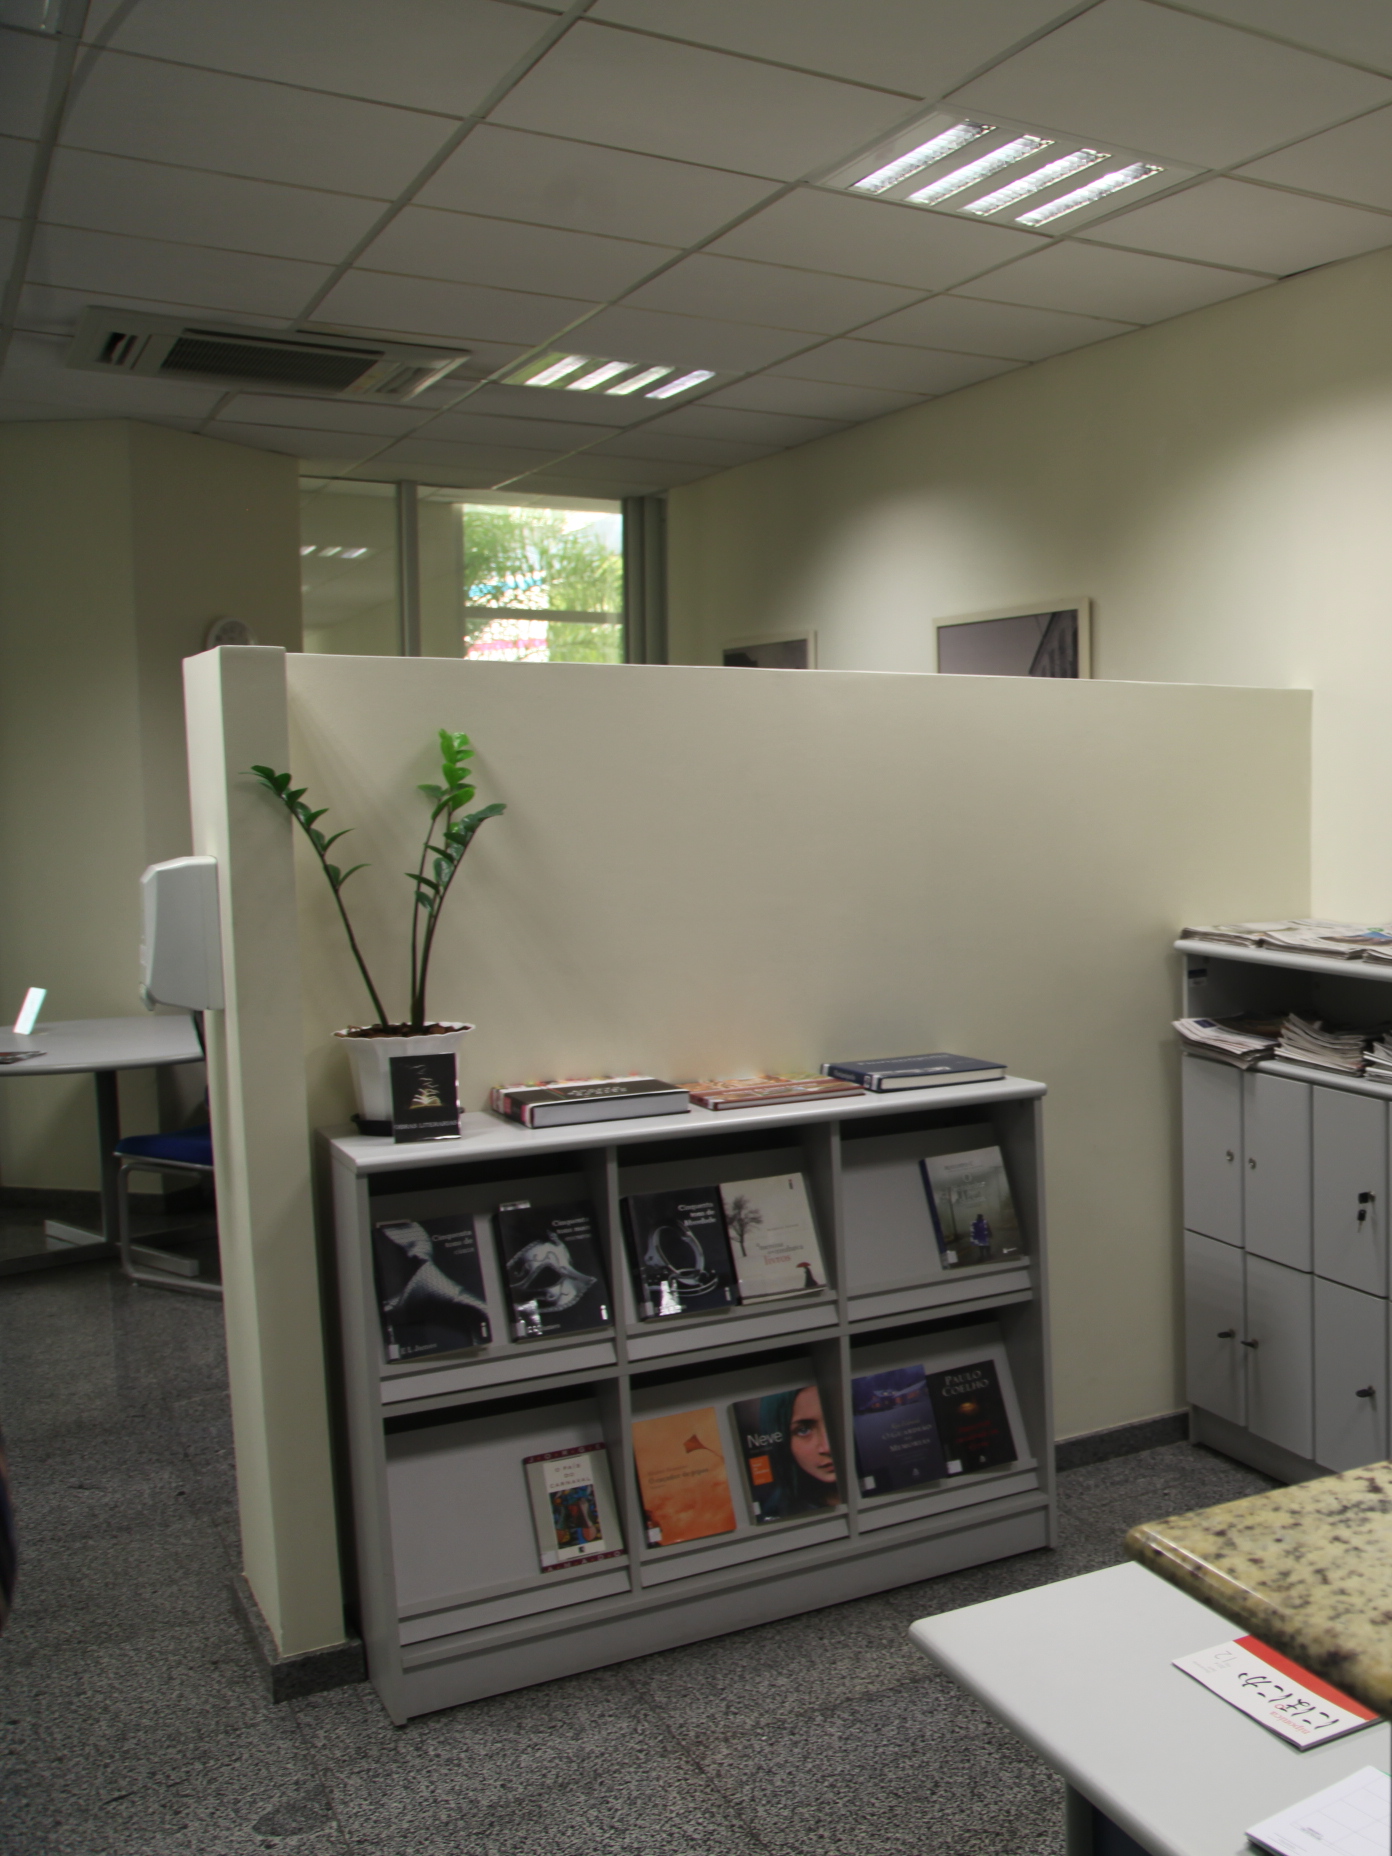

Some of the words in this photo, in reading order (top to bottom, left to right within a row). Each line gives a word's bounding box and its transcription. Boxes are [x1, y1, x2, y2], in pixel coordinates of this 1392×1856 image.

[944, 1370, 982, 1386] PAULO
[941, 1379, 990, 1397] COELHO
[746, 1431, 784, 1448] Neve
[550, 1477, 591, 1489] CARNAVAL
[1214, 1650, 1238, 1663] 12
[1270, 1710, 1310, 1735] niponica
